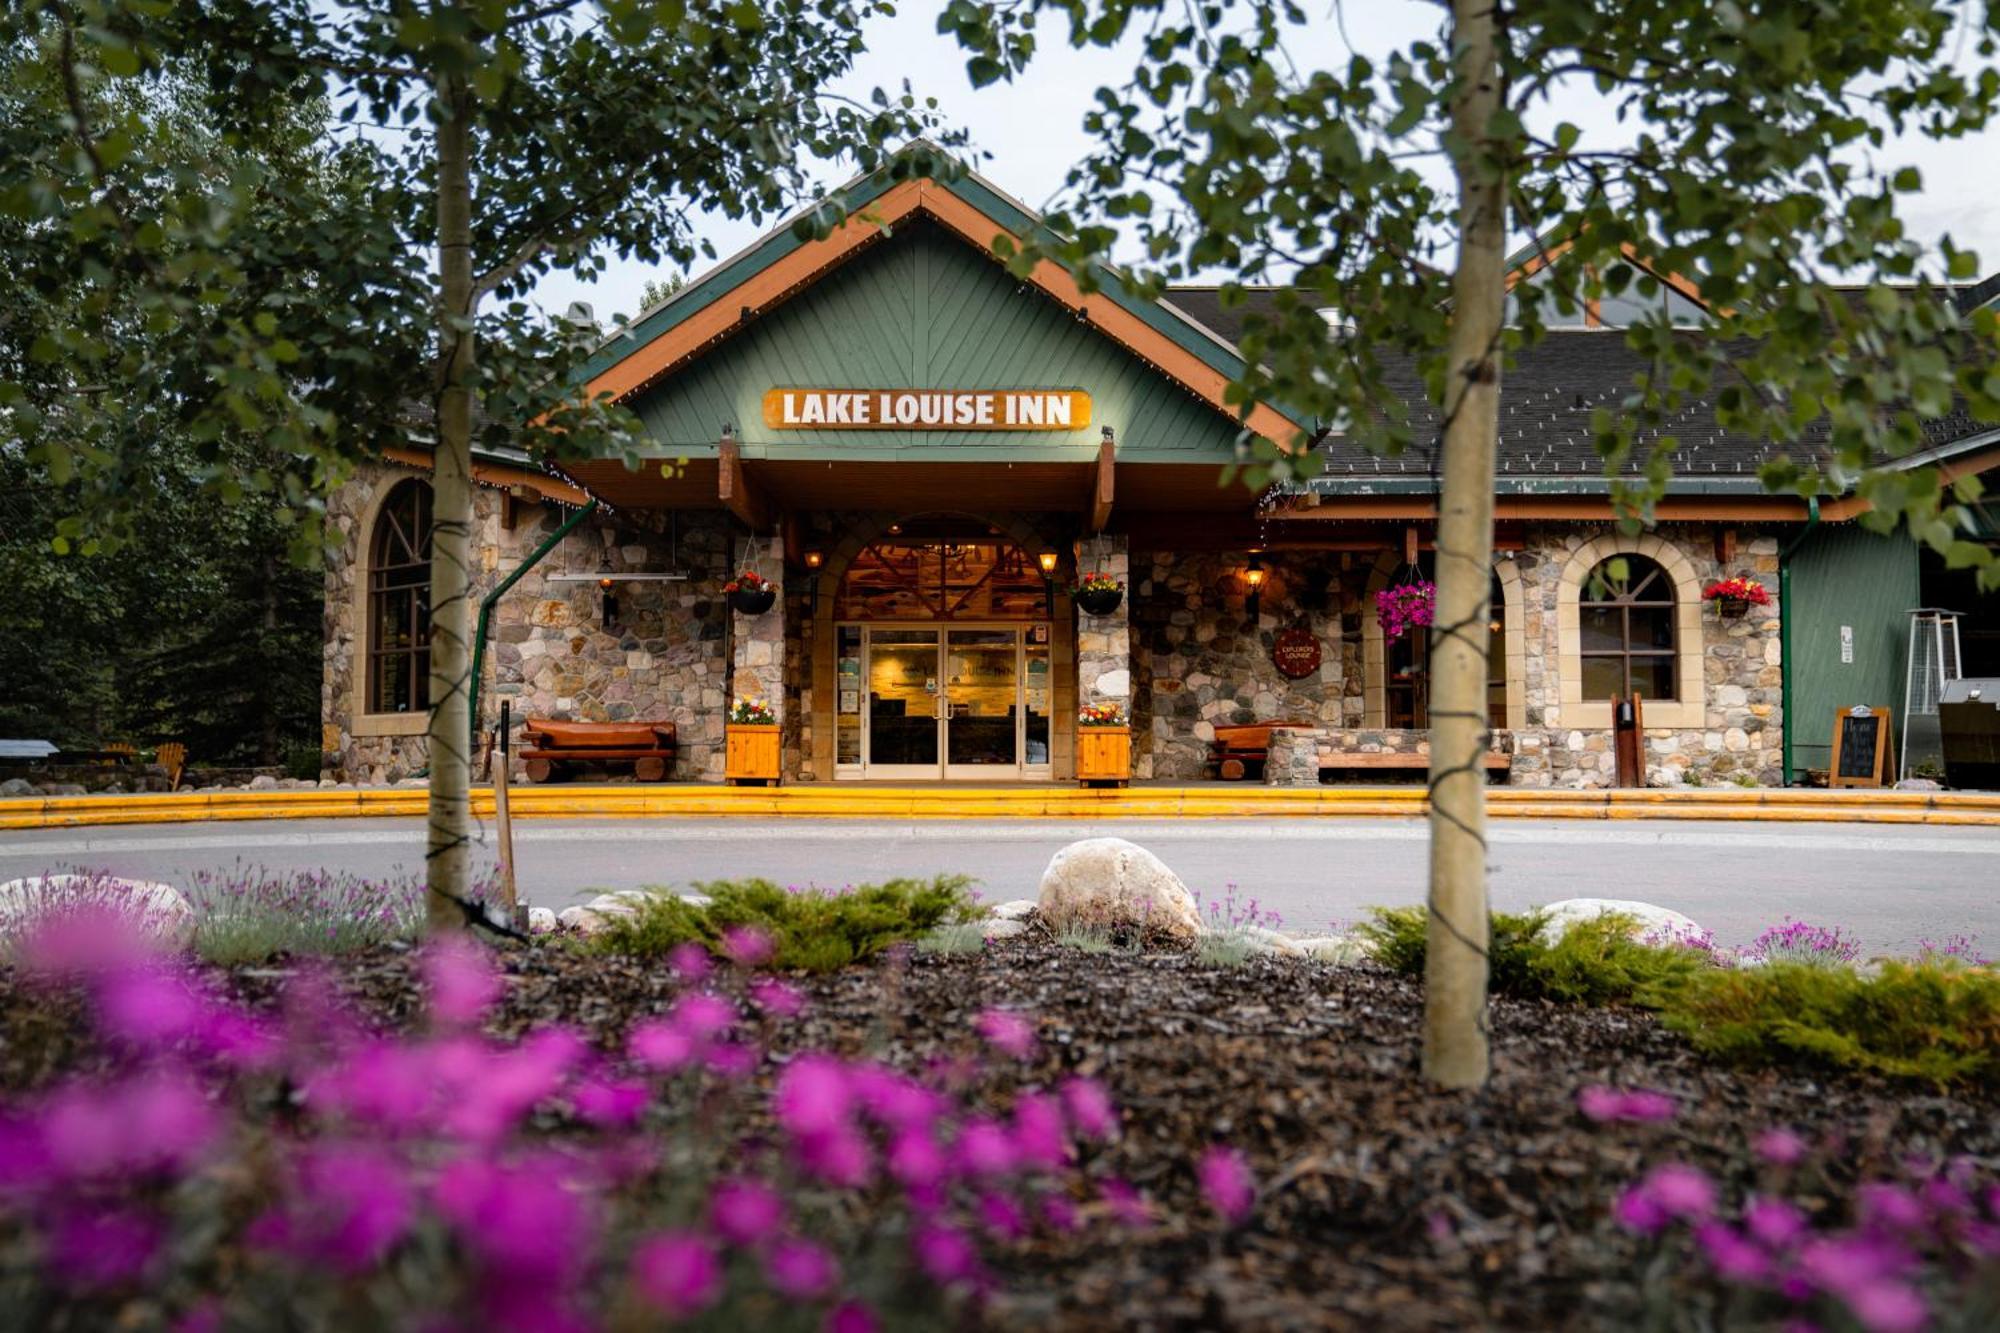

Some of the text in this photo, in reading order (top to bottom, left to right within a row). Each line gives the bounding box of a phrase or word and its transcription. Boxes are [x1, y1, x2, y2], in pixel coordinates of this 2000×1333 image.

[783, 393, 1071, 425] LAKE LOUISE INN
